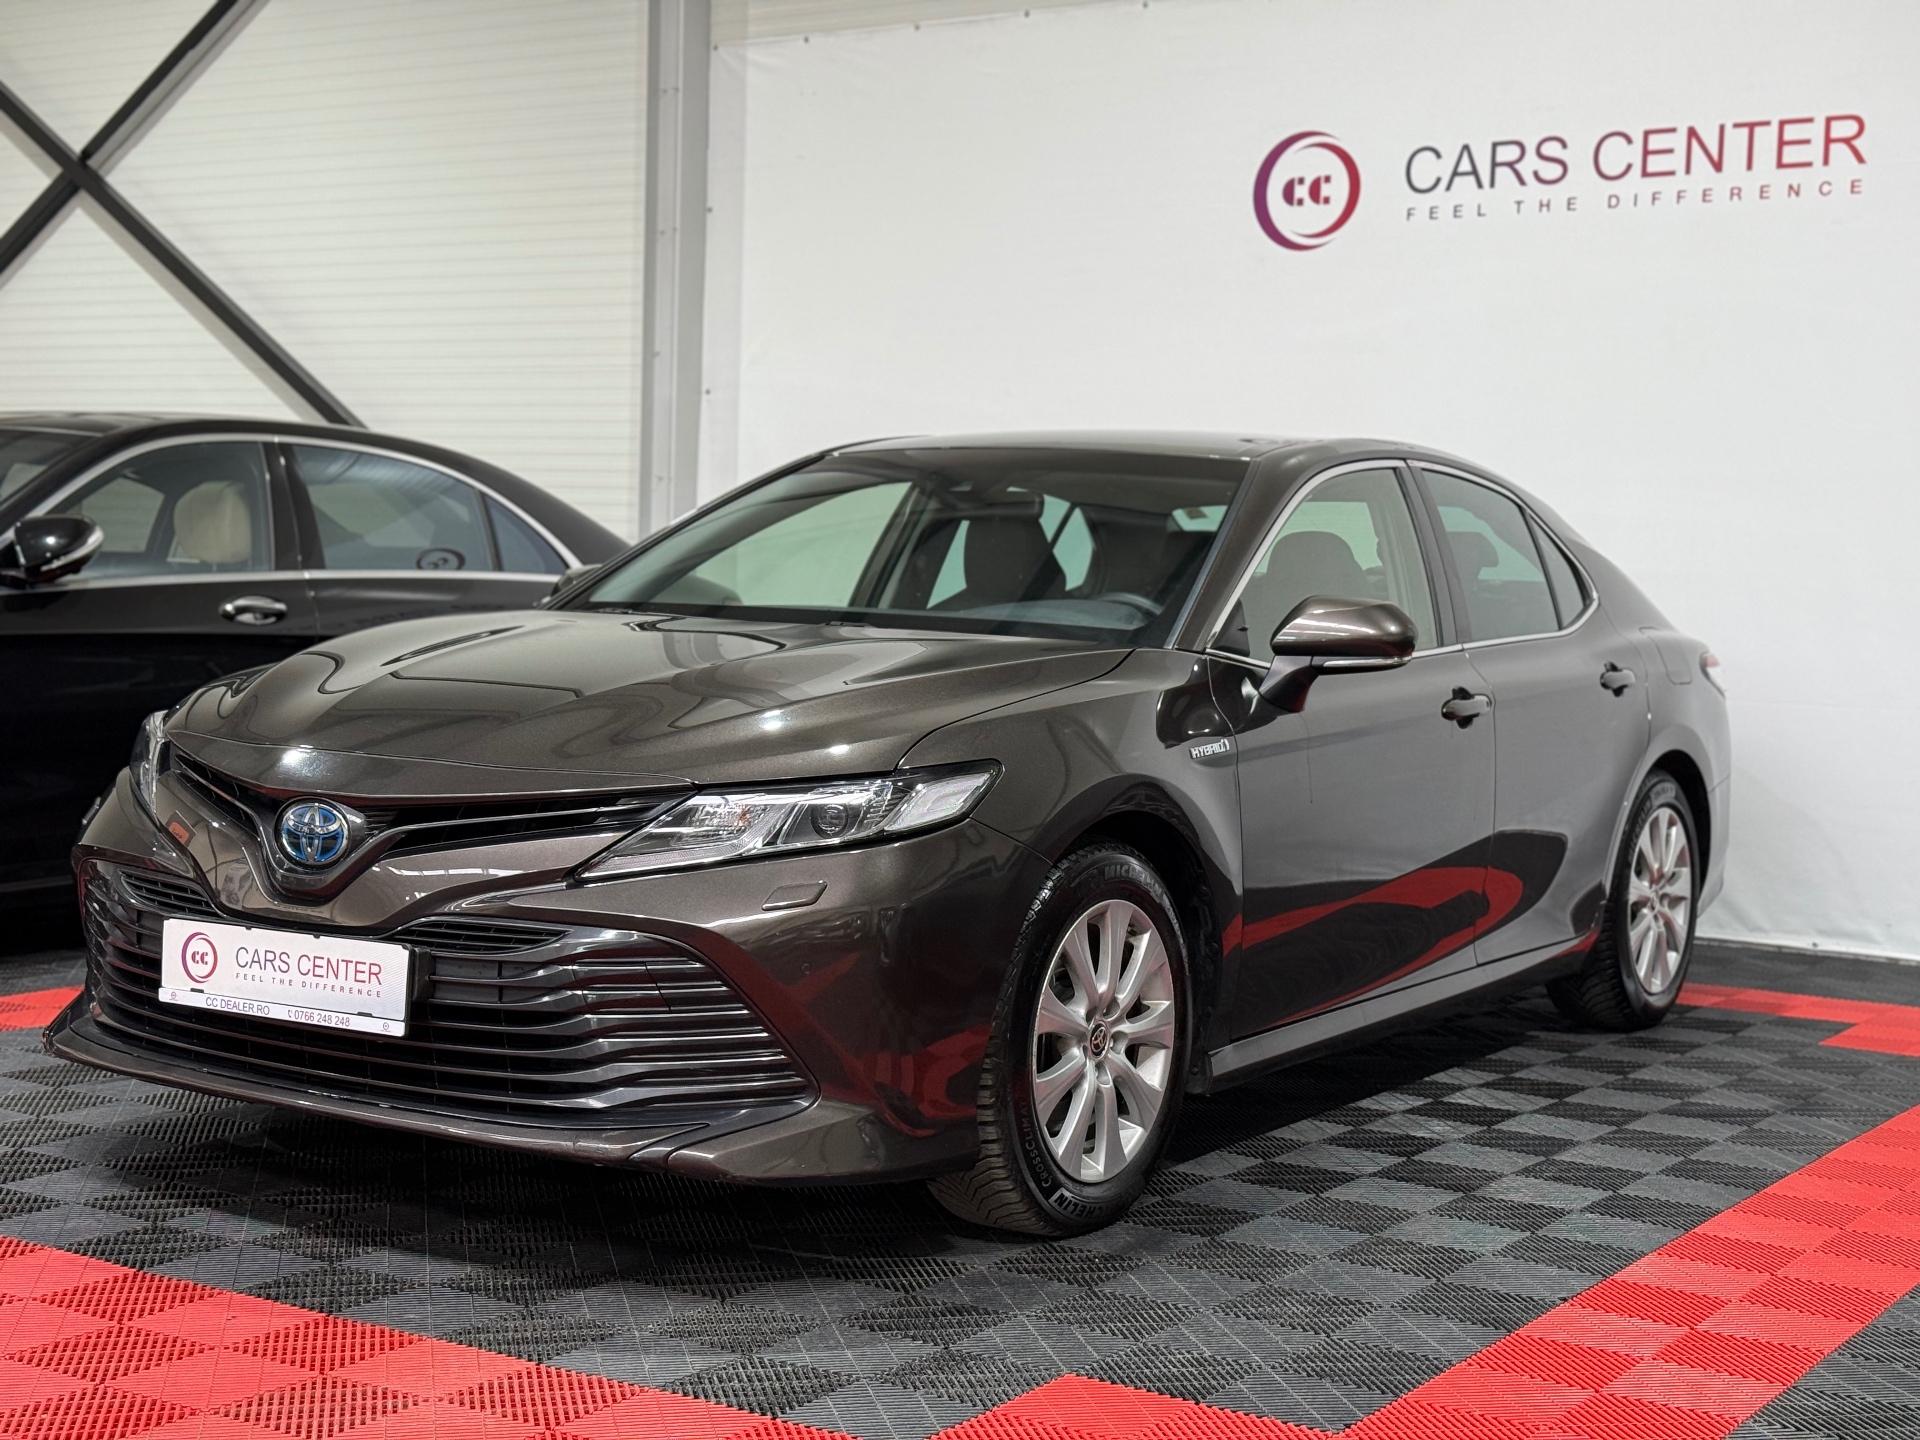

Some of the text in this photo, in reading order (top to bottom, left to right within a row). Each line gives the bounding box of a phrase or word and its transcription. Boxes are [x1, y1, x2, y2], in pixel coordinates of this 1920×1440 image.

[1405, 114, 1868, 194] CARS CENTER
[1282, 175, 1332, 207] CC
[1406, 178, 1863, 222] FEEL THE DIFFERENCE
[1190, 740, 1226, 759] HYBRID
[191, 950, 209, 966] CC
[235, 946, 383, 986] CARS CENTER
[235, 972, 382, 998] FEEL THE DIFFERENCE
[205, 996, 271, 1016] CC DEALER.RO
[294, 1010, 351, 1028] 0766 248 248
